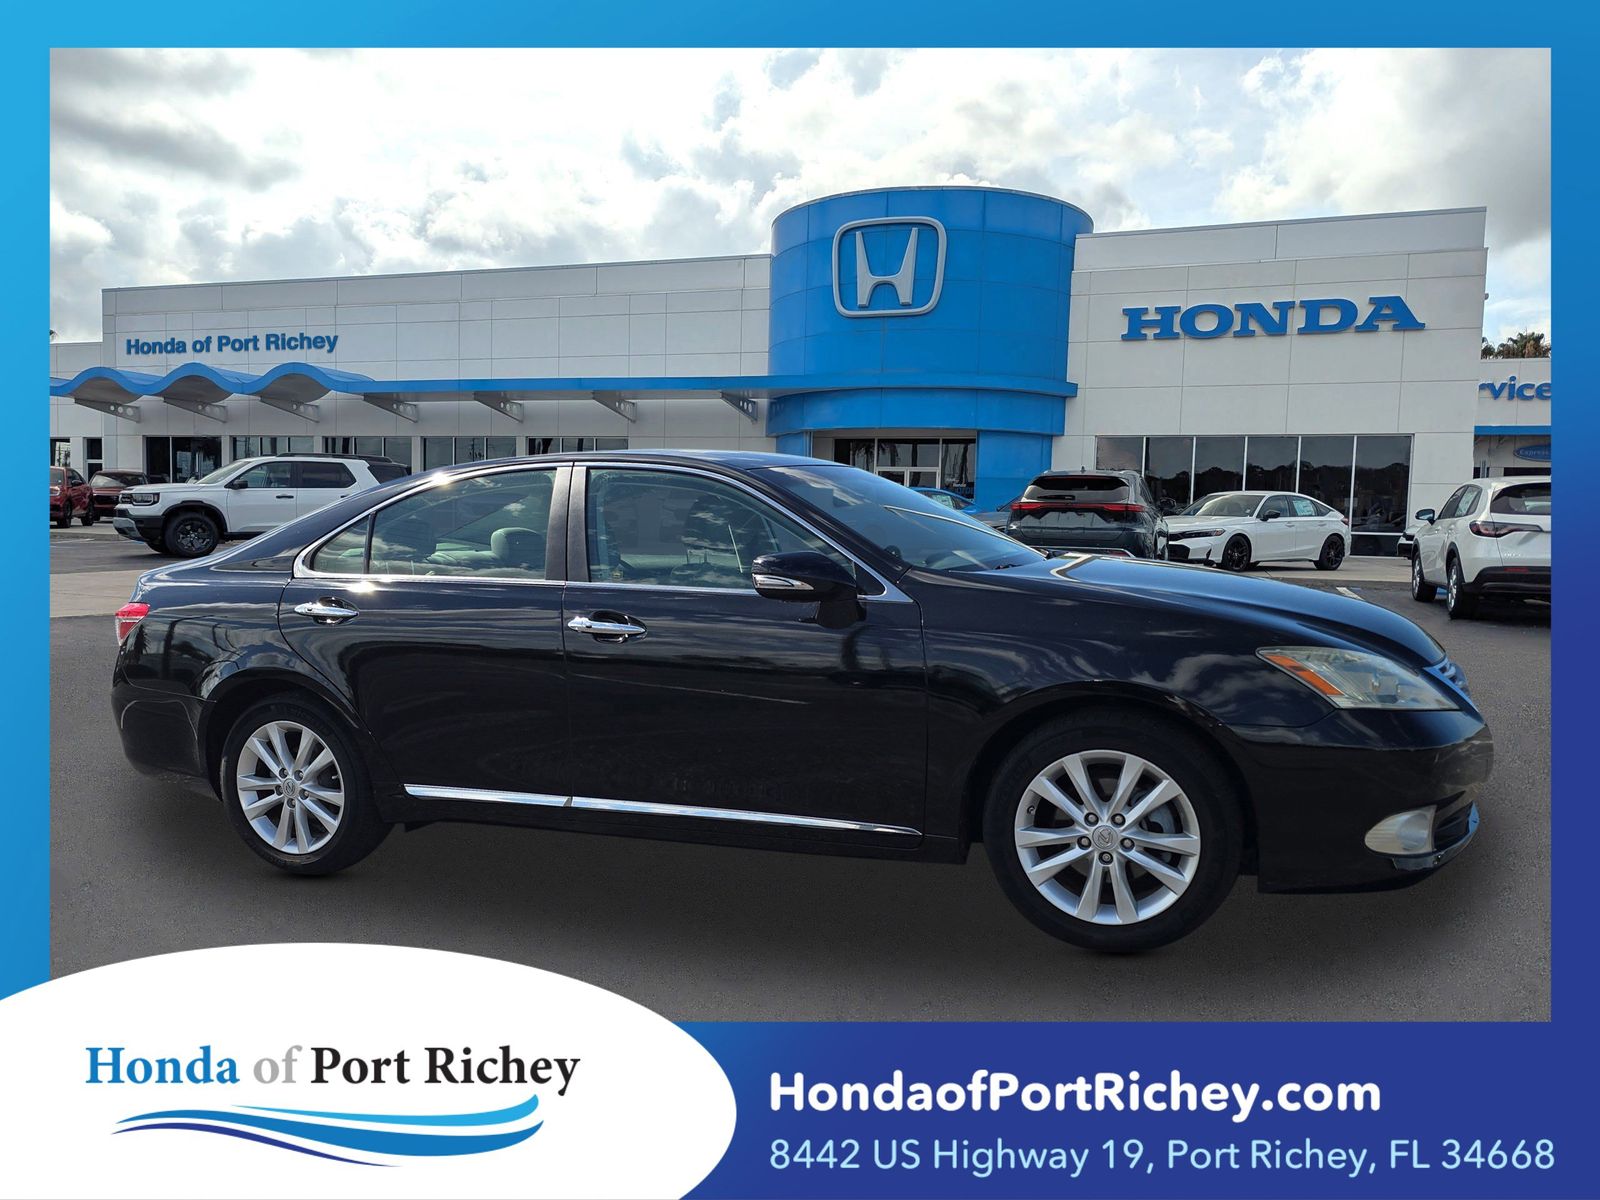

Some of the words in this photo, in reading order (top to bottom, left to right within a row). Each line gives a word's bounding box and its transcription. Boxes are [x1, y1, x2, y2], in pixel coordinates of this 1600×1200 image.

[1120, 295, 1425, 340] HONDA
[125, 338, 188, 356] Honda
[191, 336, 214, 354] of
[217, 335, 258, 353] Port
[265, 331, 339, 353] Richey
